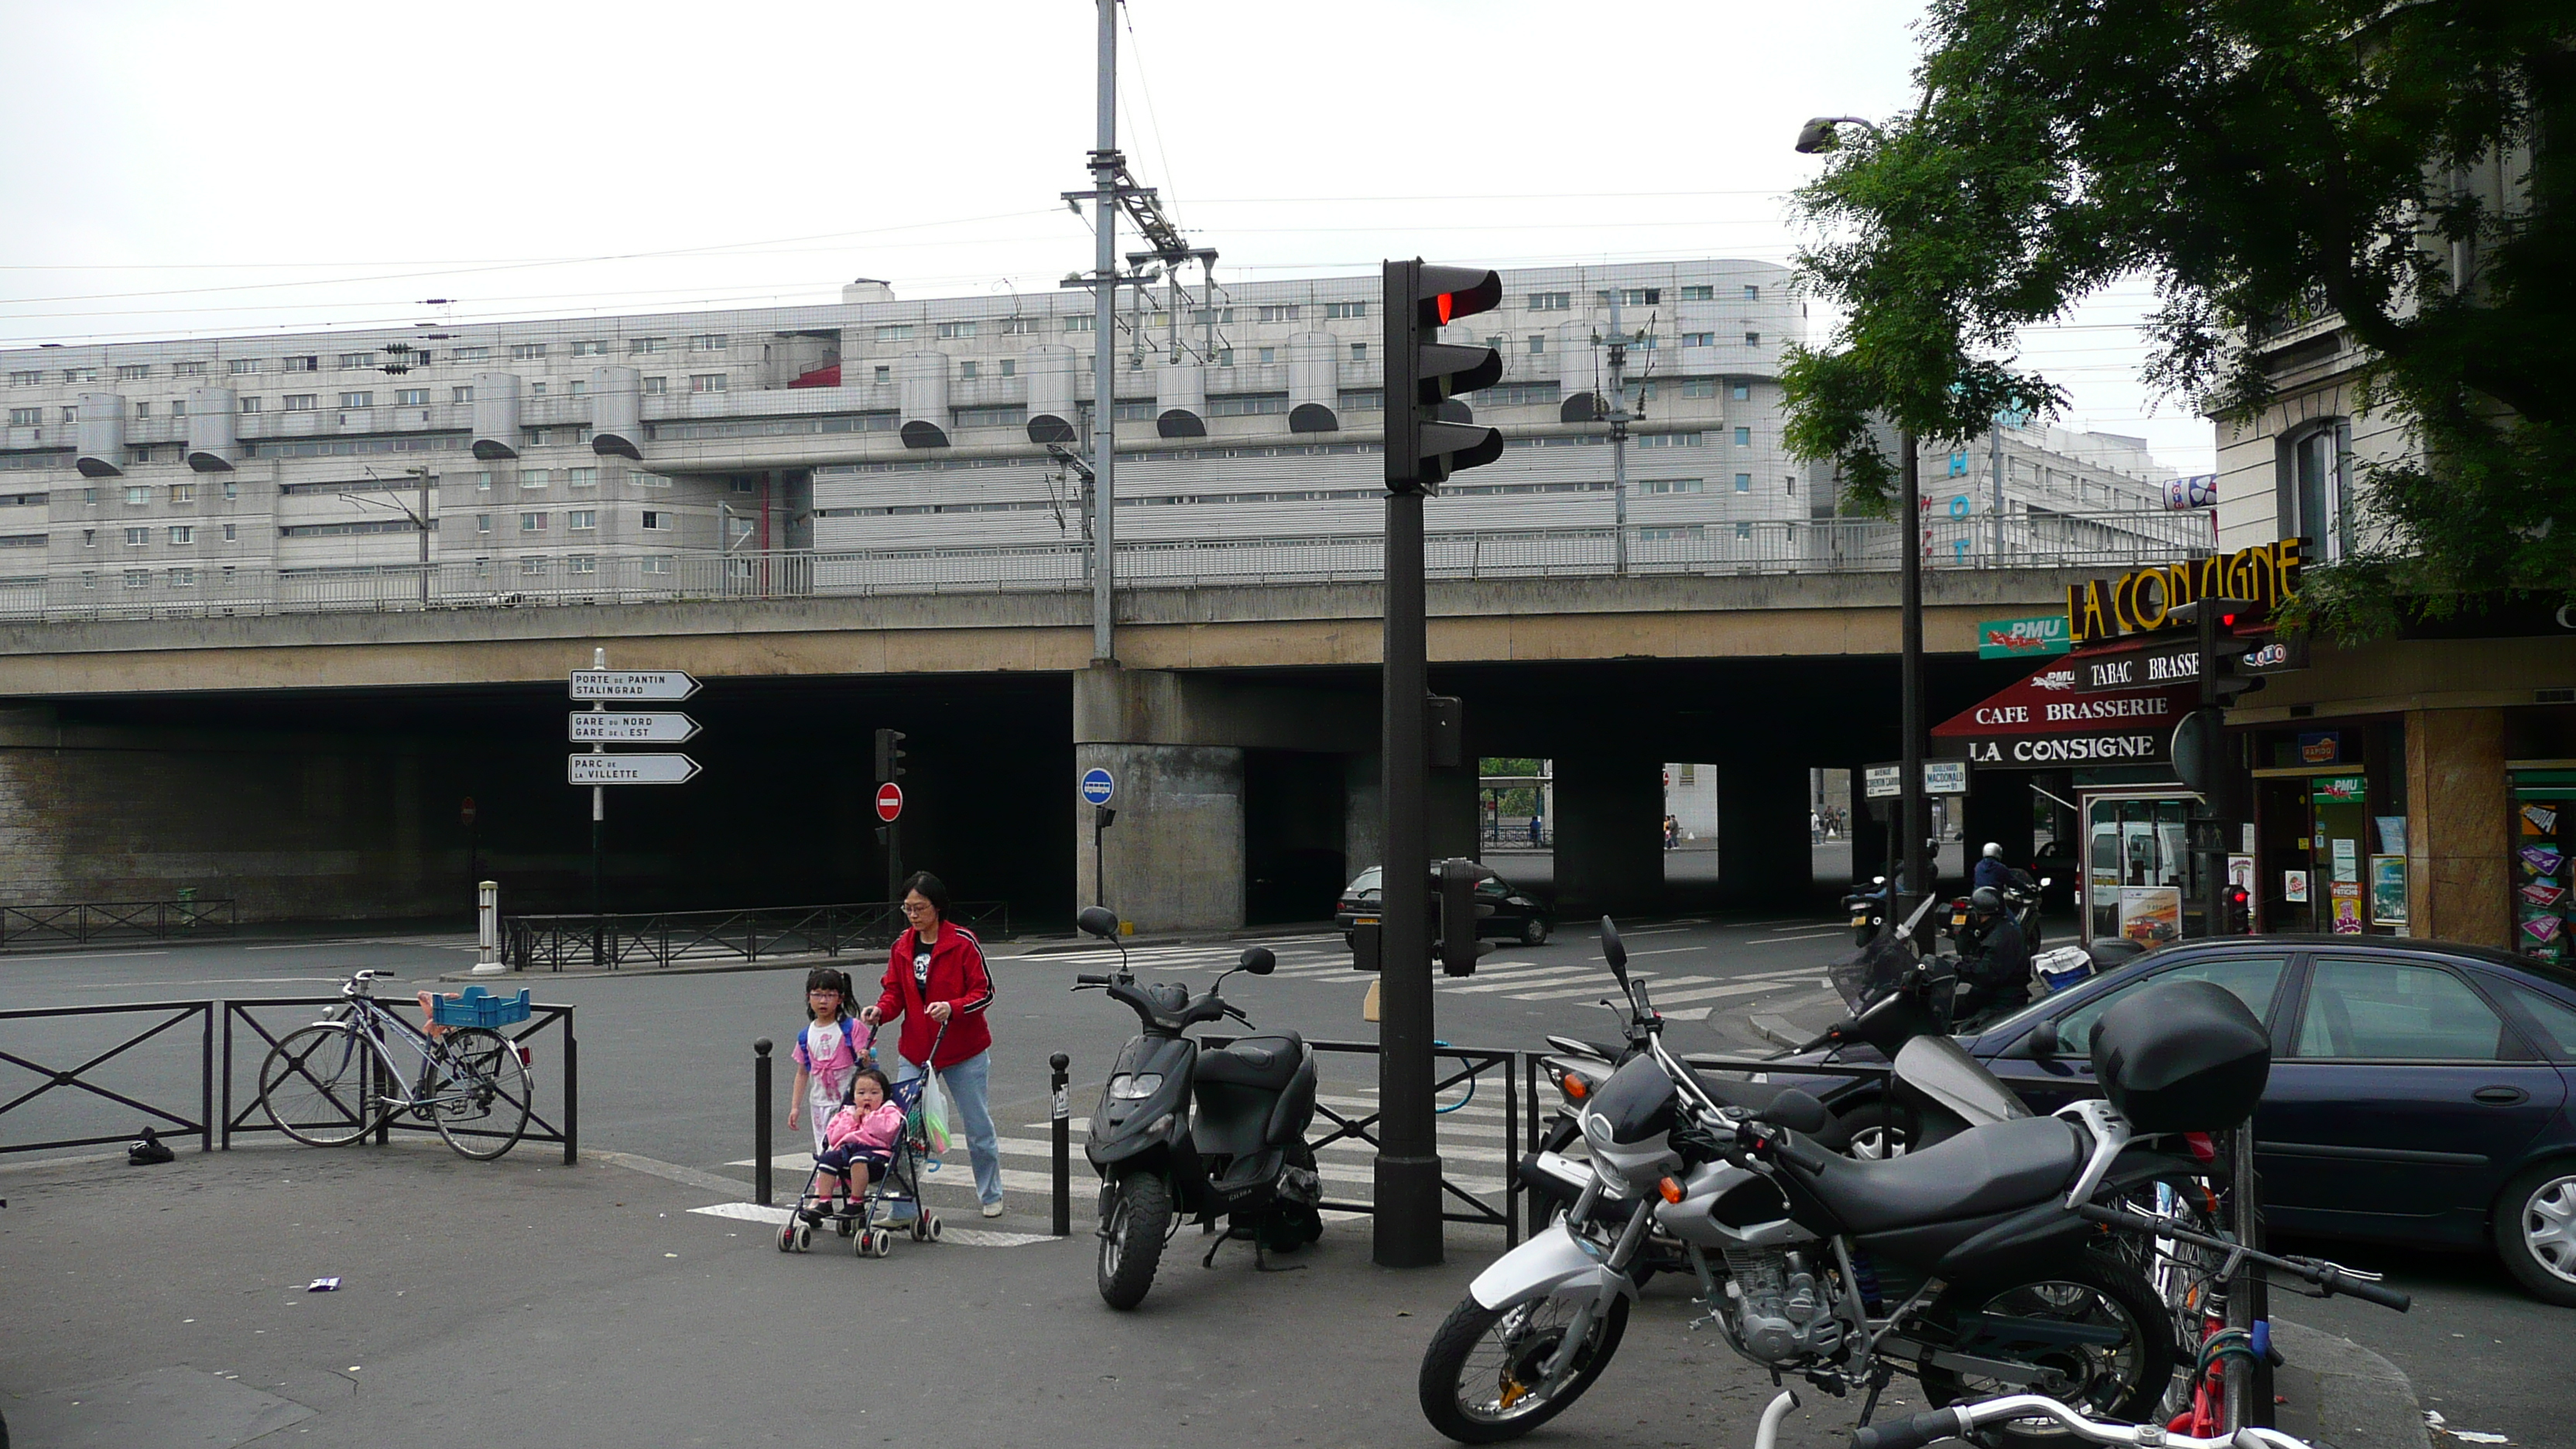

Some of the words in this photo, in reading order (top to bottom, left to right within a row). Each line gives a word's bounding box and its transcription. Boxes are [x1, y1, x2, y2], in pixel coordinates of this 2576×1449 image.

[2067, 580, 2105, 642] LA
[2114, 537, 2300, 632] CONSIGNE
[2012, 619, 2060, 638] PMU
[2244, 644, 2287, 666] LOTO
[629, 676, 666, 684] PANTIN
[2047, 670, 2074, 682] PMU
[2091, 660, 2132, 686] TABAC
[1975, 705, 2029, 724] CAFE
[2046, 697, 2169, 721] BRASSERIE
[623, 718, 653, 726] NORD
[1969, 742, 2003, 762] LA
[2013, 736, 2155, 762] CONSIGNE
[2305, 747, 2332, 755] RAPIDO
[1927, 772, 1965, 783] MACDONALD
[2334, 779, 2358, 792] PMU
